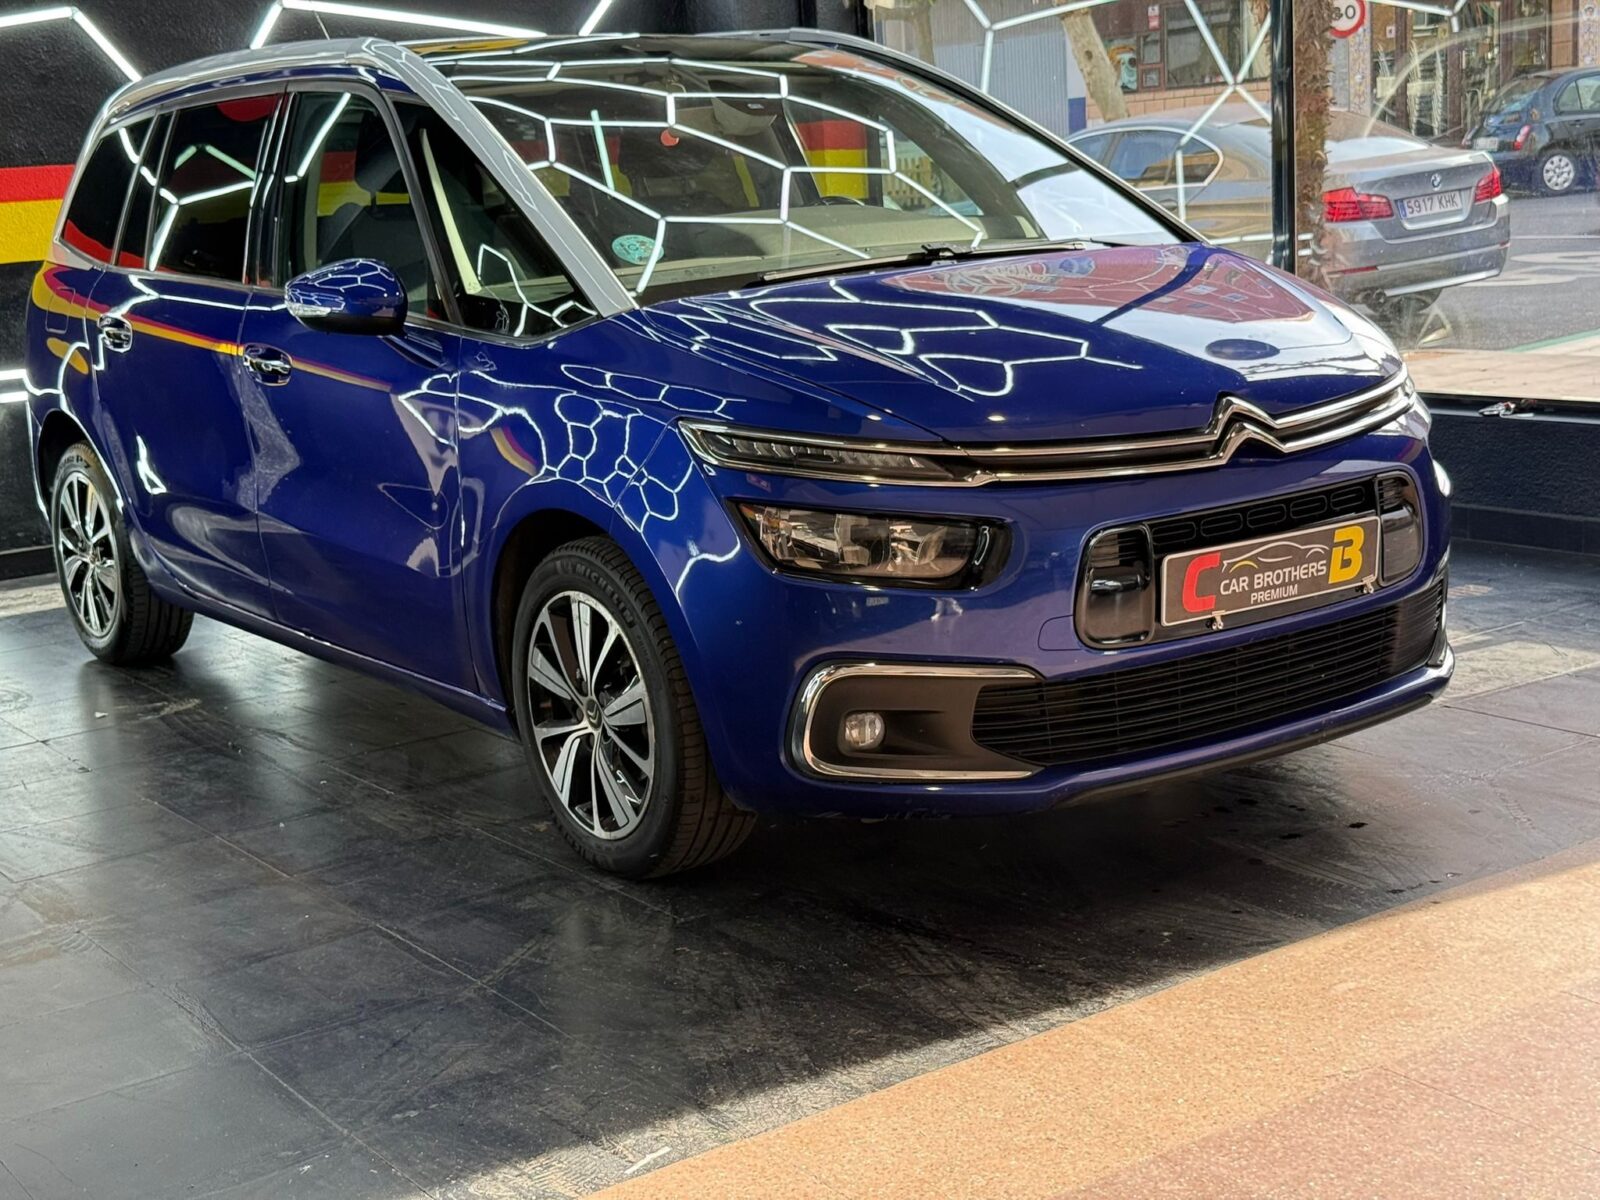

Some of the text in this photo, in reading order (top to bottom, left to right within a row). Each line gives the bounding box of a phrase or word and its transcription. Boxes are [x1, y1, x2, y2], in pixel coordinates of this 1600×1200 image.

[1406, 193, 1458, 215] 5917 KHK
[1219, 560, 1327, 596] CAR BROTHERS
[1328, 525, 1365, 584] B
[575, 563, 635, 624] MICHELIN
[1182, 551, 1221, 613] C
[1249, 583, 1298, 605] PREMIUM
